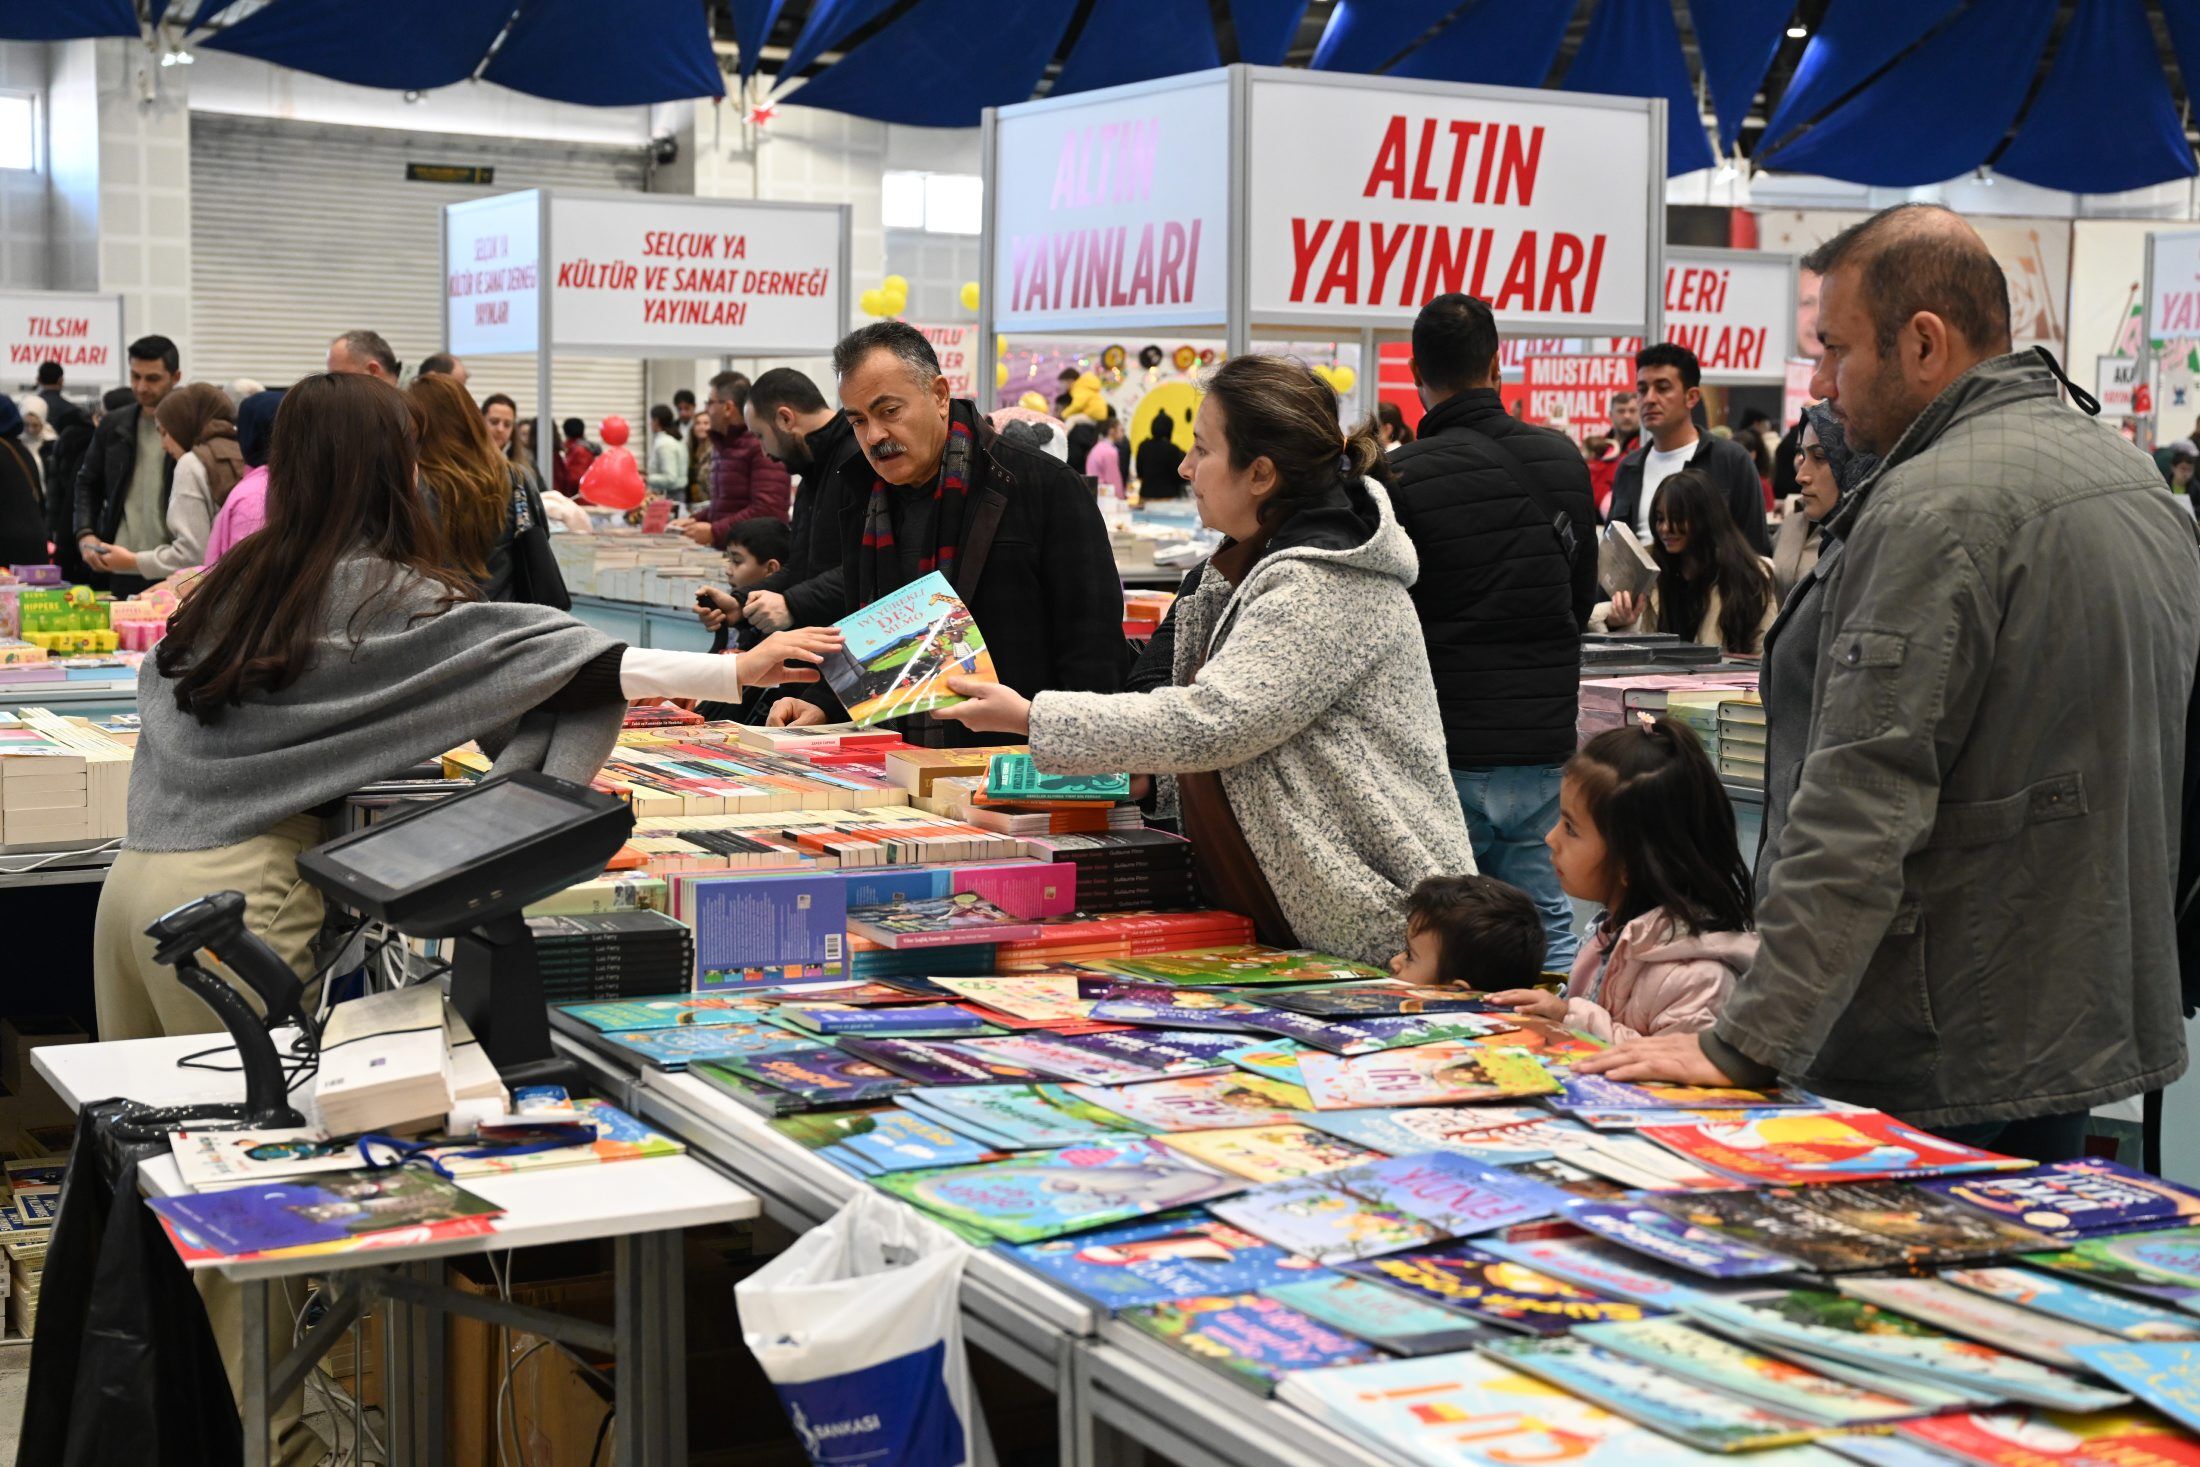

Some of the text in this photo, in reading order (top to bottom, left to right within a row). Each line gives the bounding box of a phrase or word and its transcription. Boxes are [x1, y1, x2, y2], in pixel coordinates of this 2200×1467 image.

[1050, 118, 1159, 211] ALTIN
[1362, 115, 1545, 207] ALTIN
[642, 231, 746, 260] SELÇUK YA
[557, 260, 829, 297] KÜLTÜR VE SANAT DERNEĞİ
[1011, 217, 1202, 312] YAYINLARI
[1289, 217, 1606, 313] YAYINLARI
[27, 316, 90, 338] TILSIM
[643, 299, 747, 326] YAYINLARI
[10, 344, 108, 365] YAYINLARI
[1530, 358, 1629, 386] MUSTAFA
